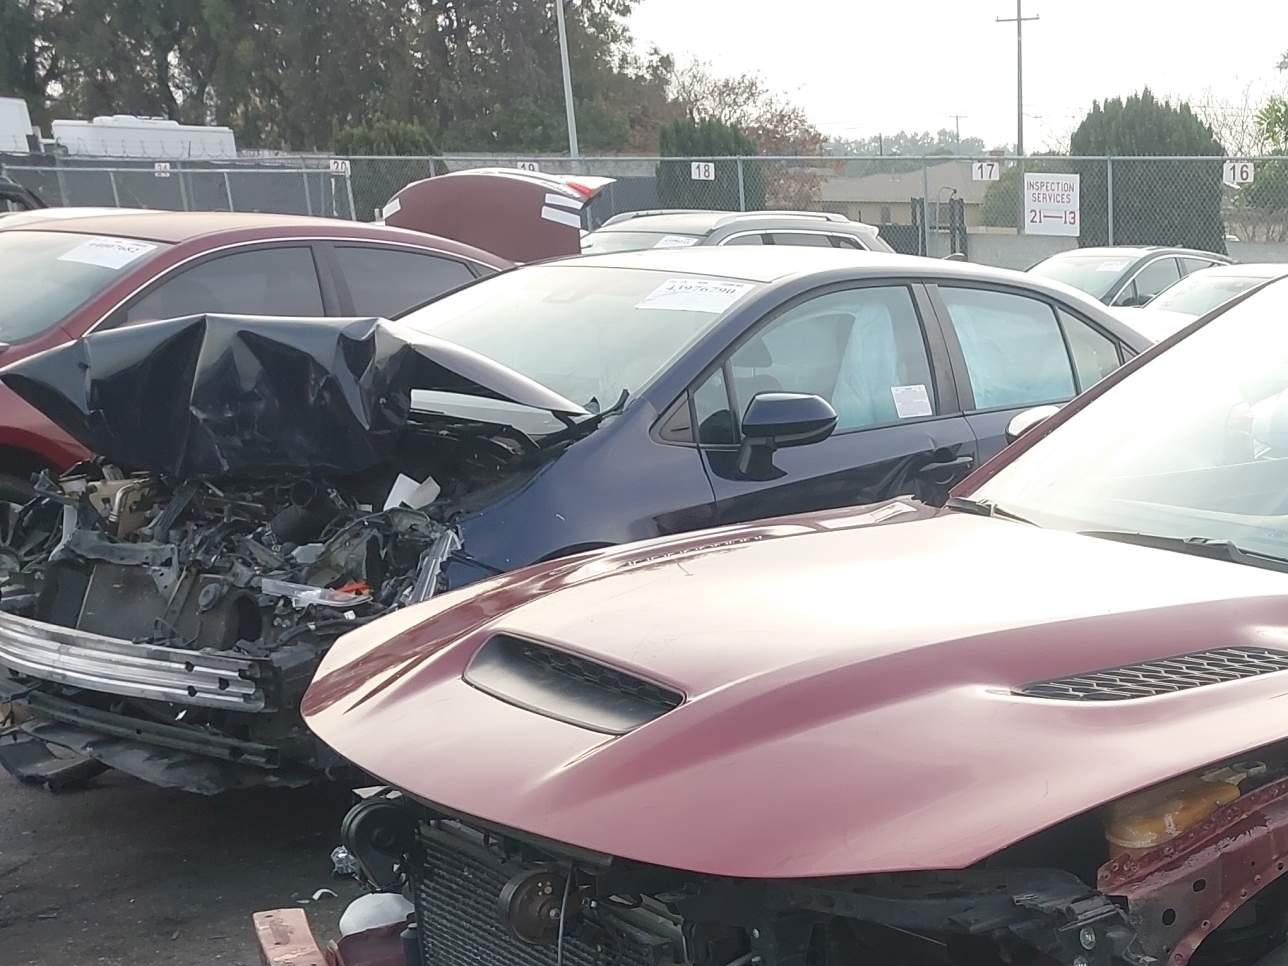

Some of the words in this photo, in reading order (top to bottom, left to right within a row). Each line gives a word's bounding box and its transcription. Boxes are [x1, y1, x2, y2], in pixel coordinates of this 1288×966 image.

[696, 163, 710, 178] 18
[977, 163, 994, 179] 17
[1230, 163, 1249, 181] 16
[1026, 181, 1075, 192] INSPECTION
[1031, 192, 1072, 204] SERVICES
